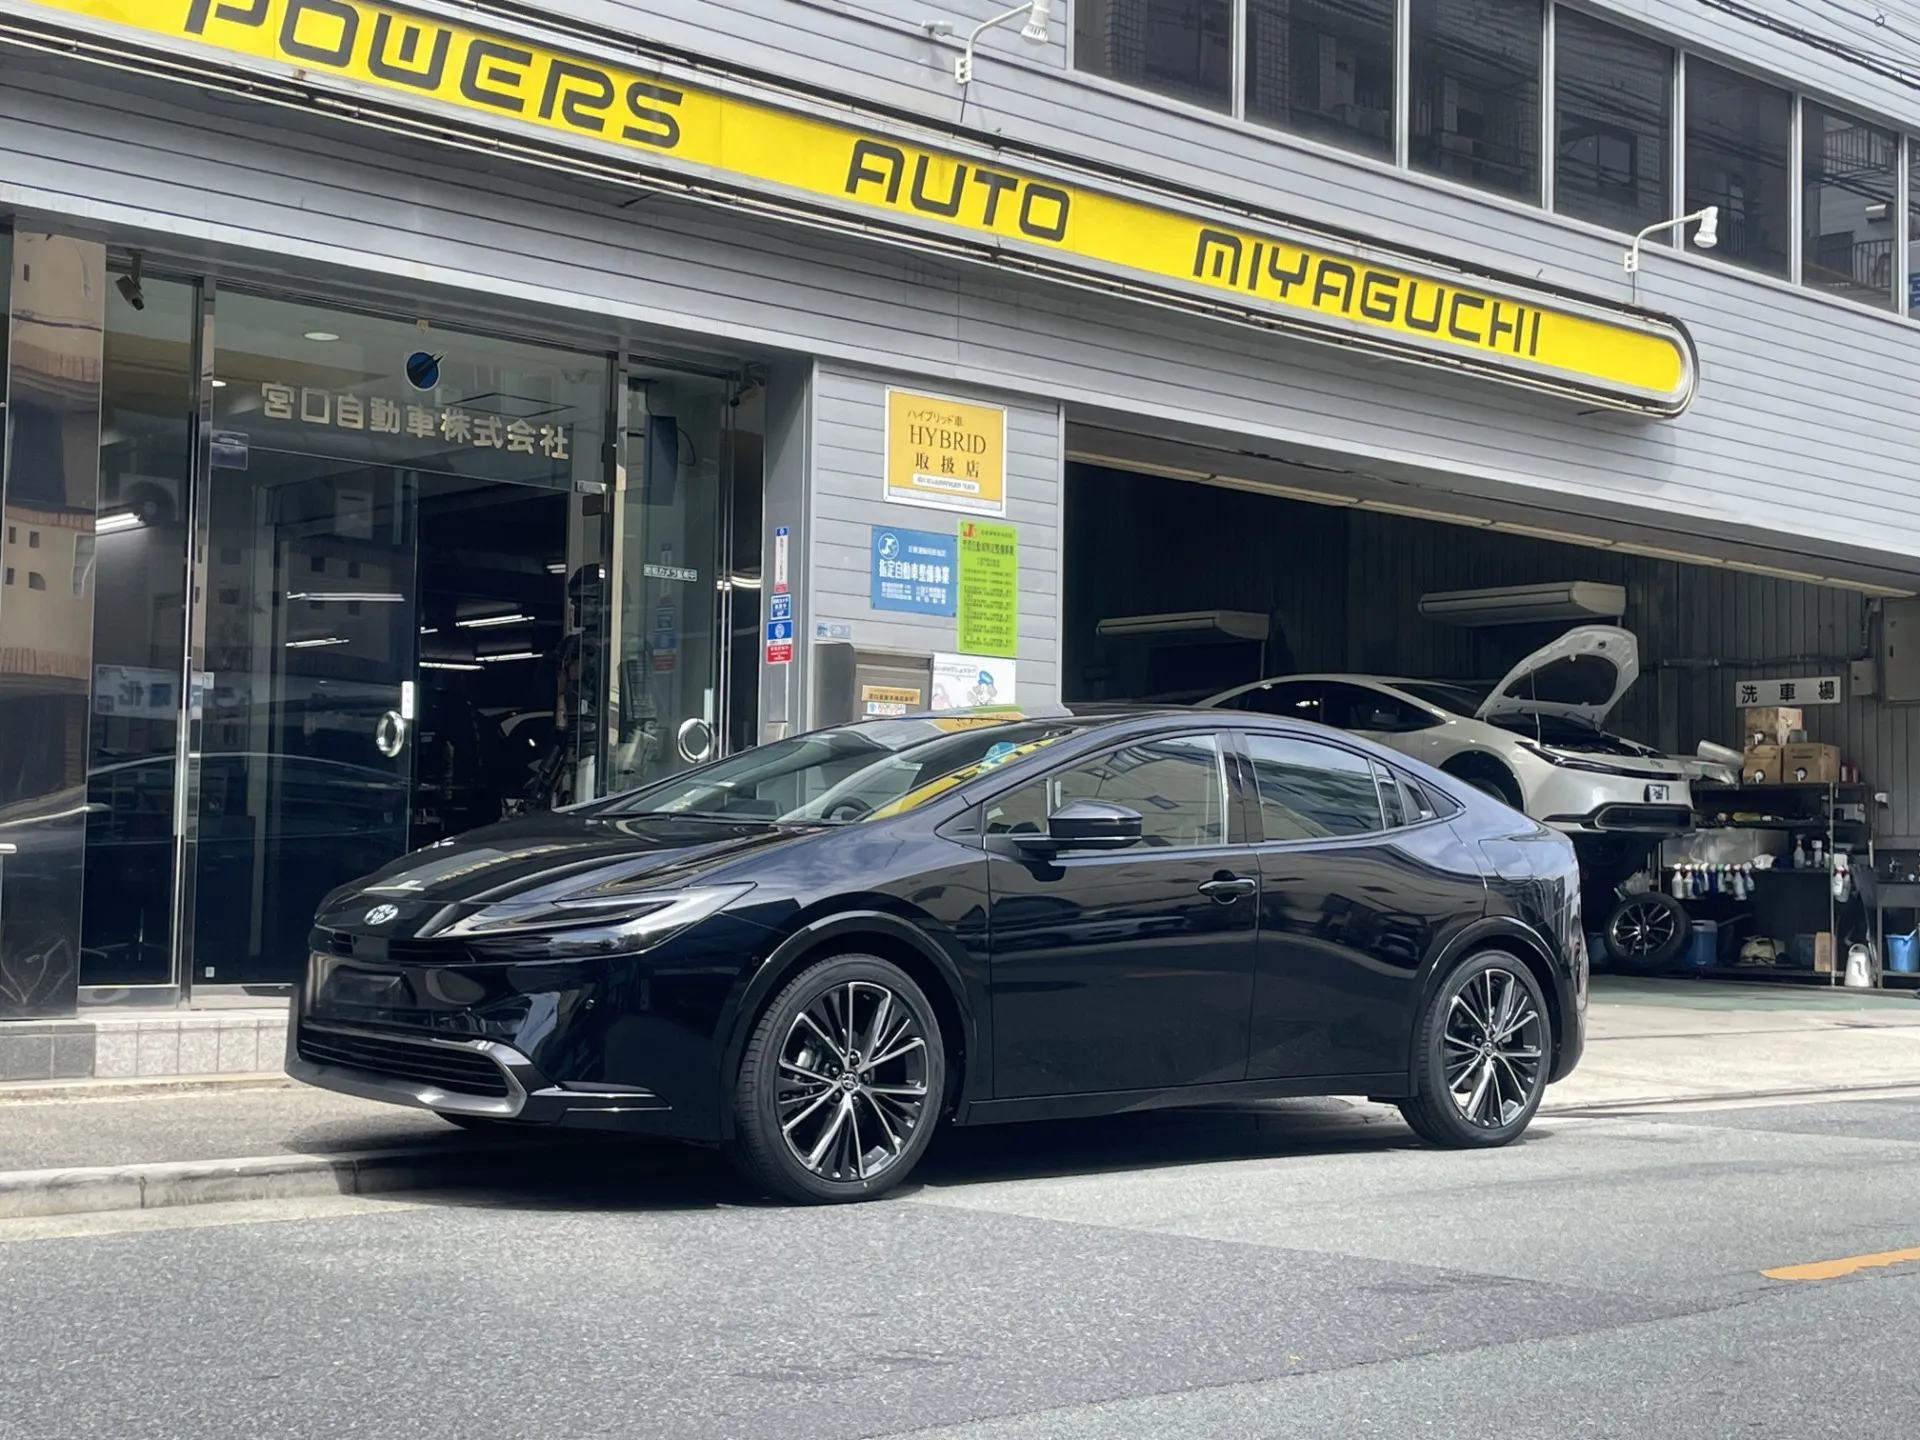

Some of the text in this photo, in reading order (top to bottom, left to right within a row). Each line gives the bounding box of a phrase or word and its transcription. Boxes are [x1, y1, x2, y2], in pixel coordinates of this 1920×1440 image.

[845, 139, 1070, 242] AUTO
[1194, 228, 1542, 357] MIYAGUCHI
[261, 382, 569, 460] 宮口自動車株式会社
[907, 410, 963, 427] ハイブリッド車
[909, 424, 987, 454] HYBRID
[1741, 680, 1835, 704] 洗車場
